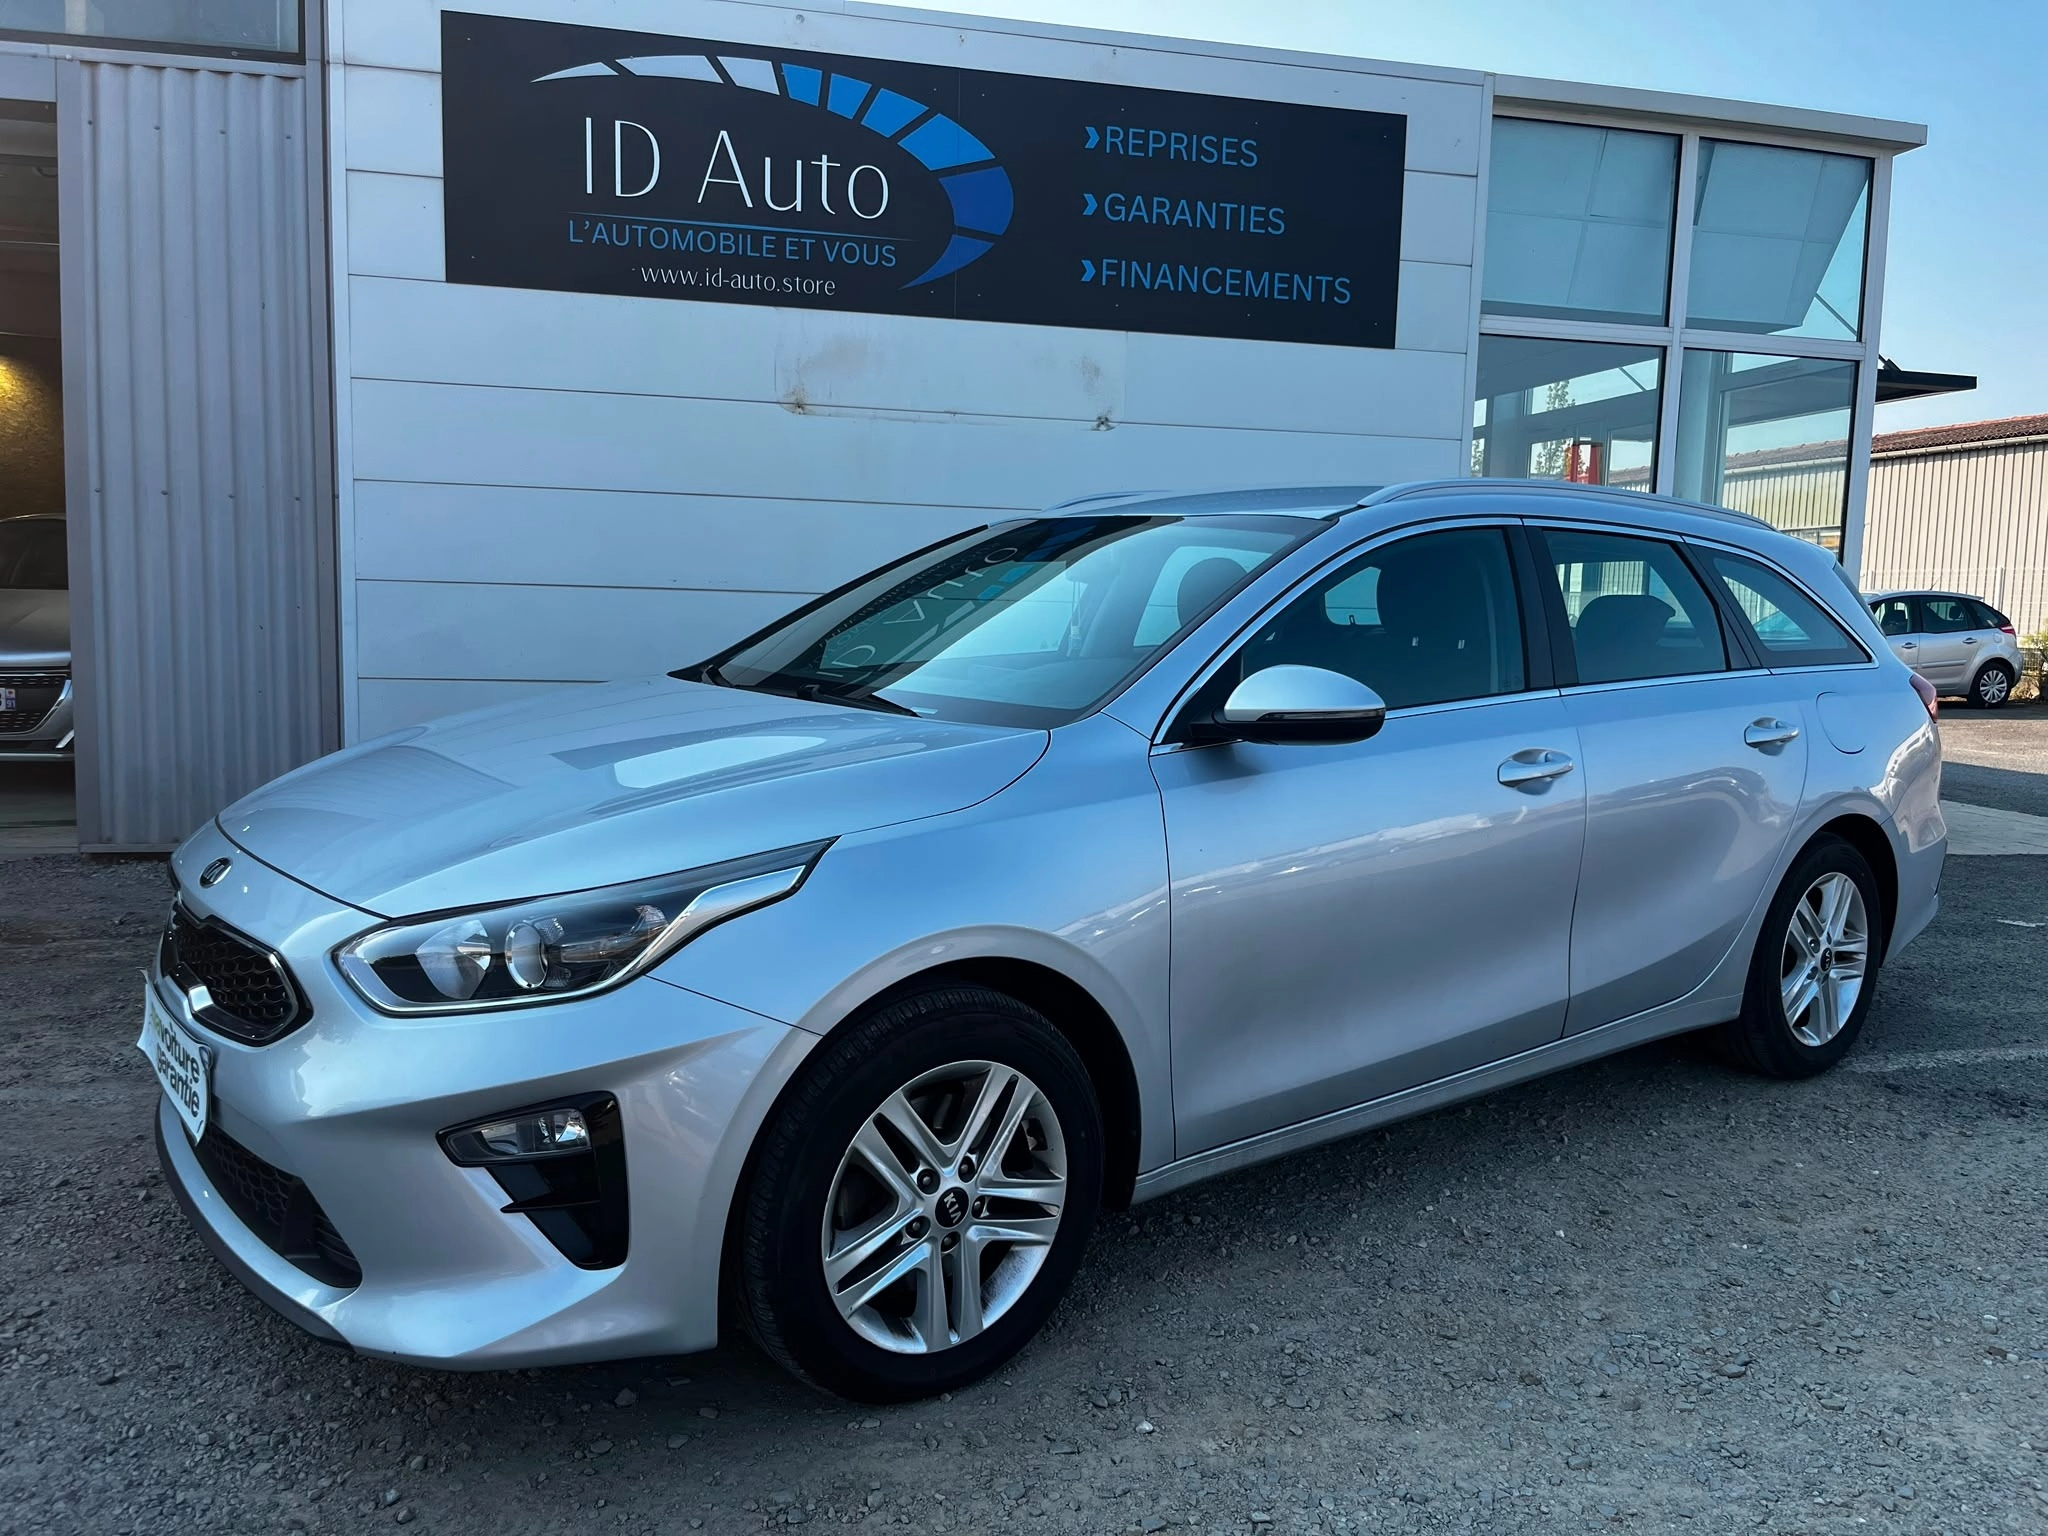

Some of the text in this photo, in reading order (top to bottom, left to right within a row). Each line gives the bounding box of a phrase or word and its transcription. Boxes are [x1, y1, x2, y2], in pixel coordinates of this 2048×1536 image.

[1105, 126, 1258, 168] REPRISES
[585, 117, 889, 220] ID Auto
[1104, 192, 1286, 235] GARANTIES
[785, 237, 816, 261] ET
[823, 240, 897, 267] VOUS
[641, 267, 836, 296] www.id-auto.store
[1102, 258, 1351, 304] FINANCEMENTS
[161, 1021, 200, 1084] voiture
[943, 1191, 962, 1224] KIA
